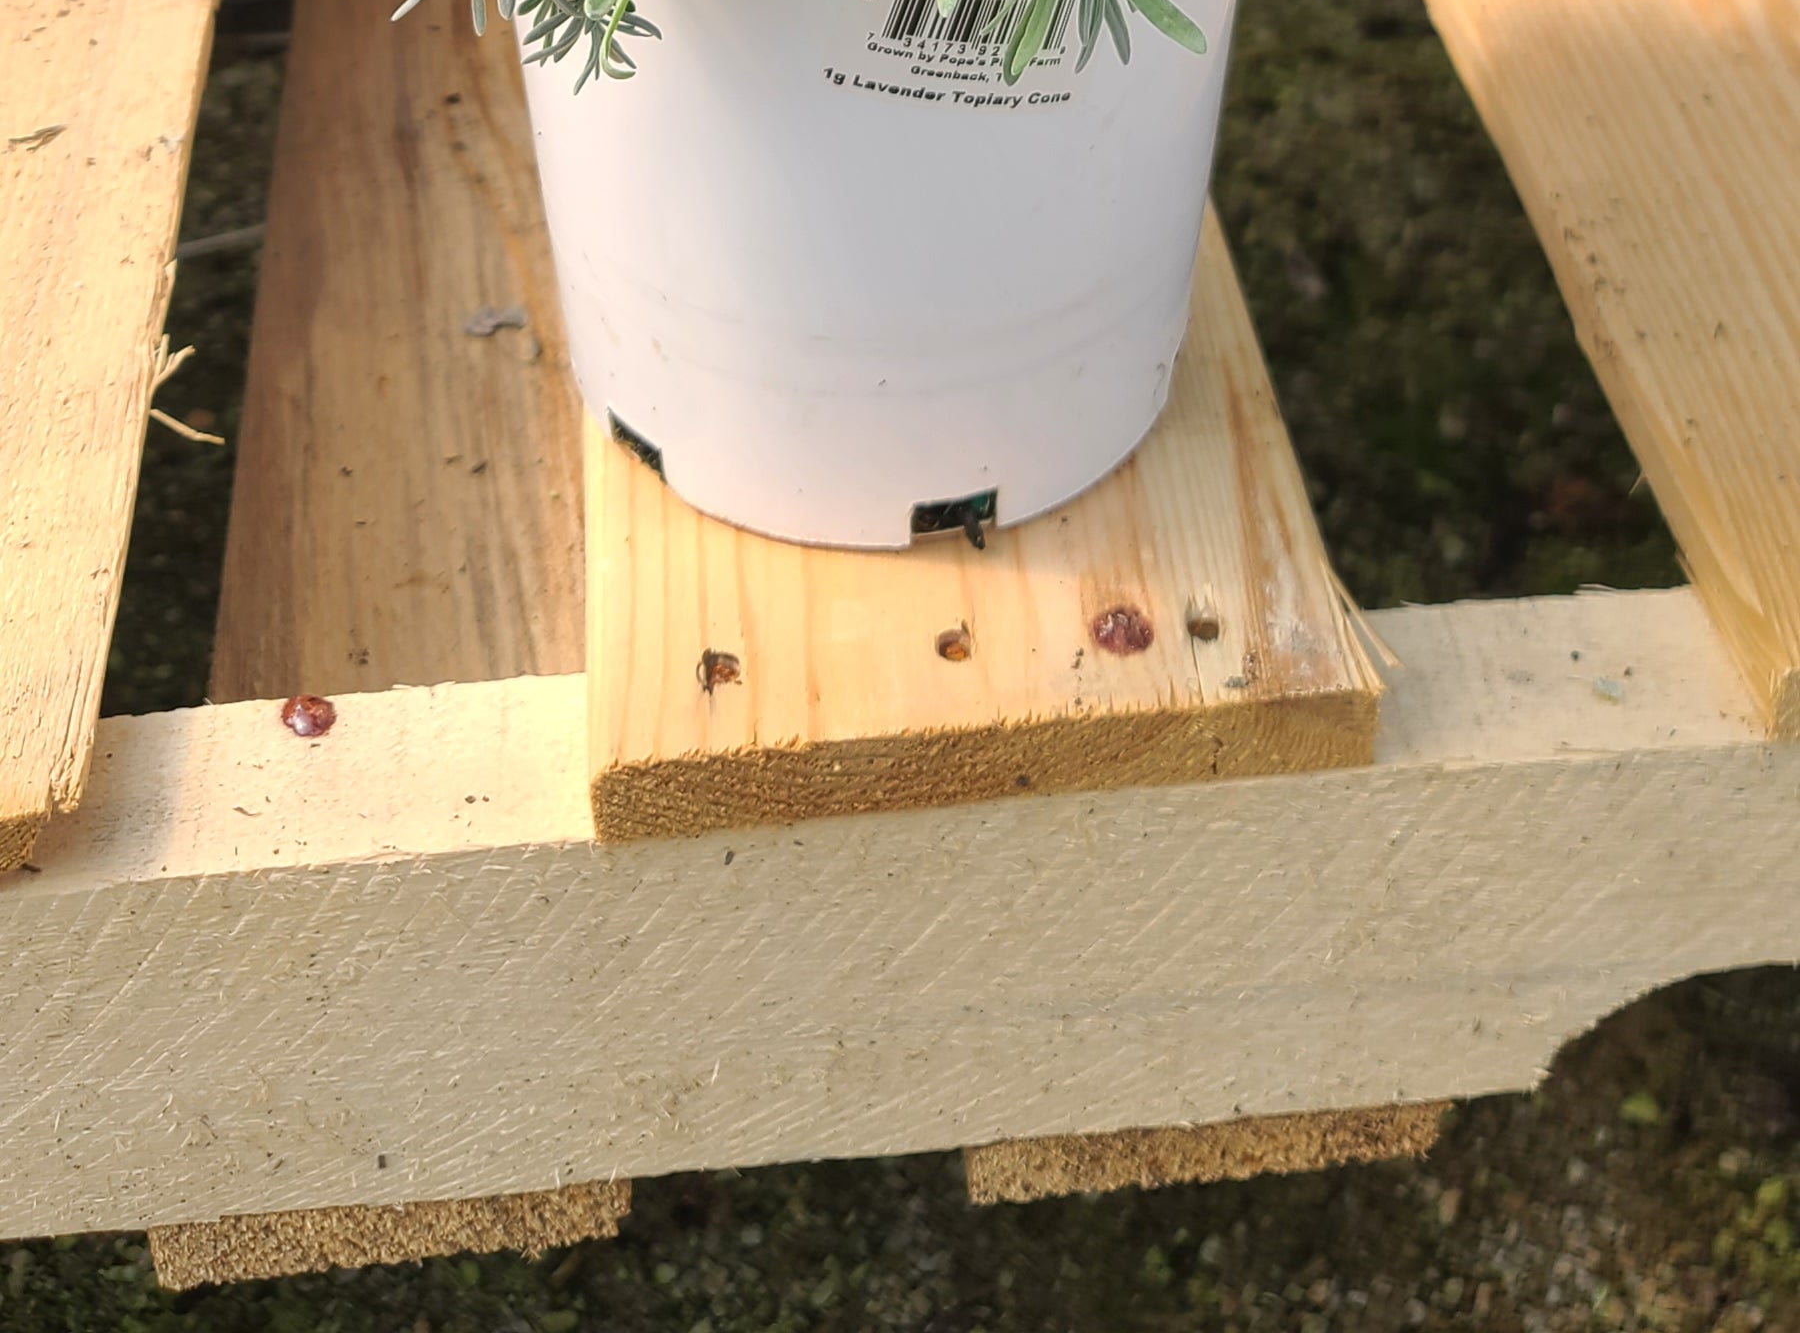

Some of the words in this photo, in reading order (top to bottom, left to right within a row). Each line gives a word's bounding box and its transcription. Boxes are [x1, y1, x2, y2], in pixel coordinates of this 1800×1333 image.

[866, 32, 875, 41] 7
[903, 37, 966, 55] 34173
[867, 42, 913, 59] Grown
[918, 51, 935, 63] by
[939, 54, 986, 67] Pope's
[1029, 57, 1061, 67] Farm
[911, 65, 990, 83] Greenback,
[823, 67, 846, 85] 1g
[852, 74, 946, 101] Lavender
[951, 91, 1024, 108] Topiary
[1028, 92, 1071, 105] Cone
